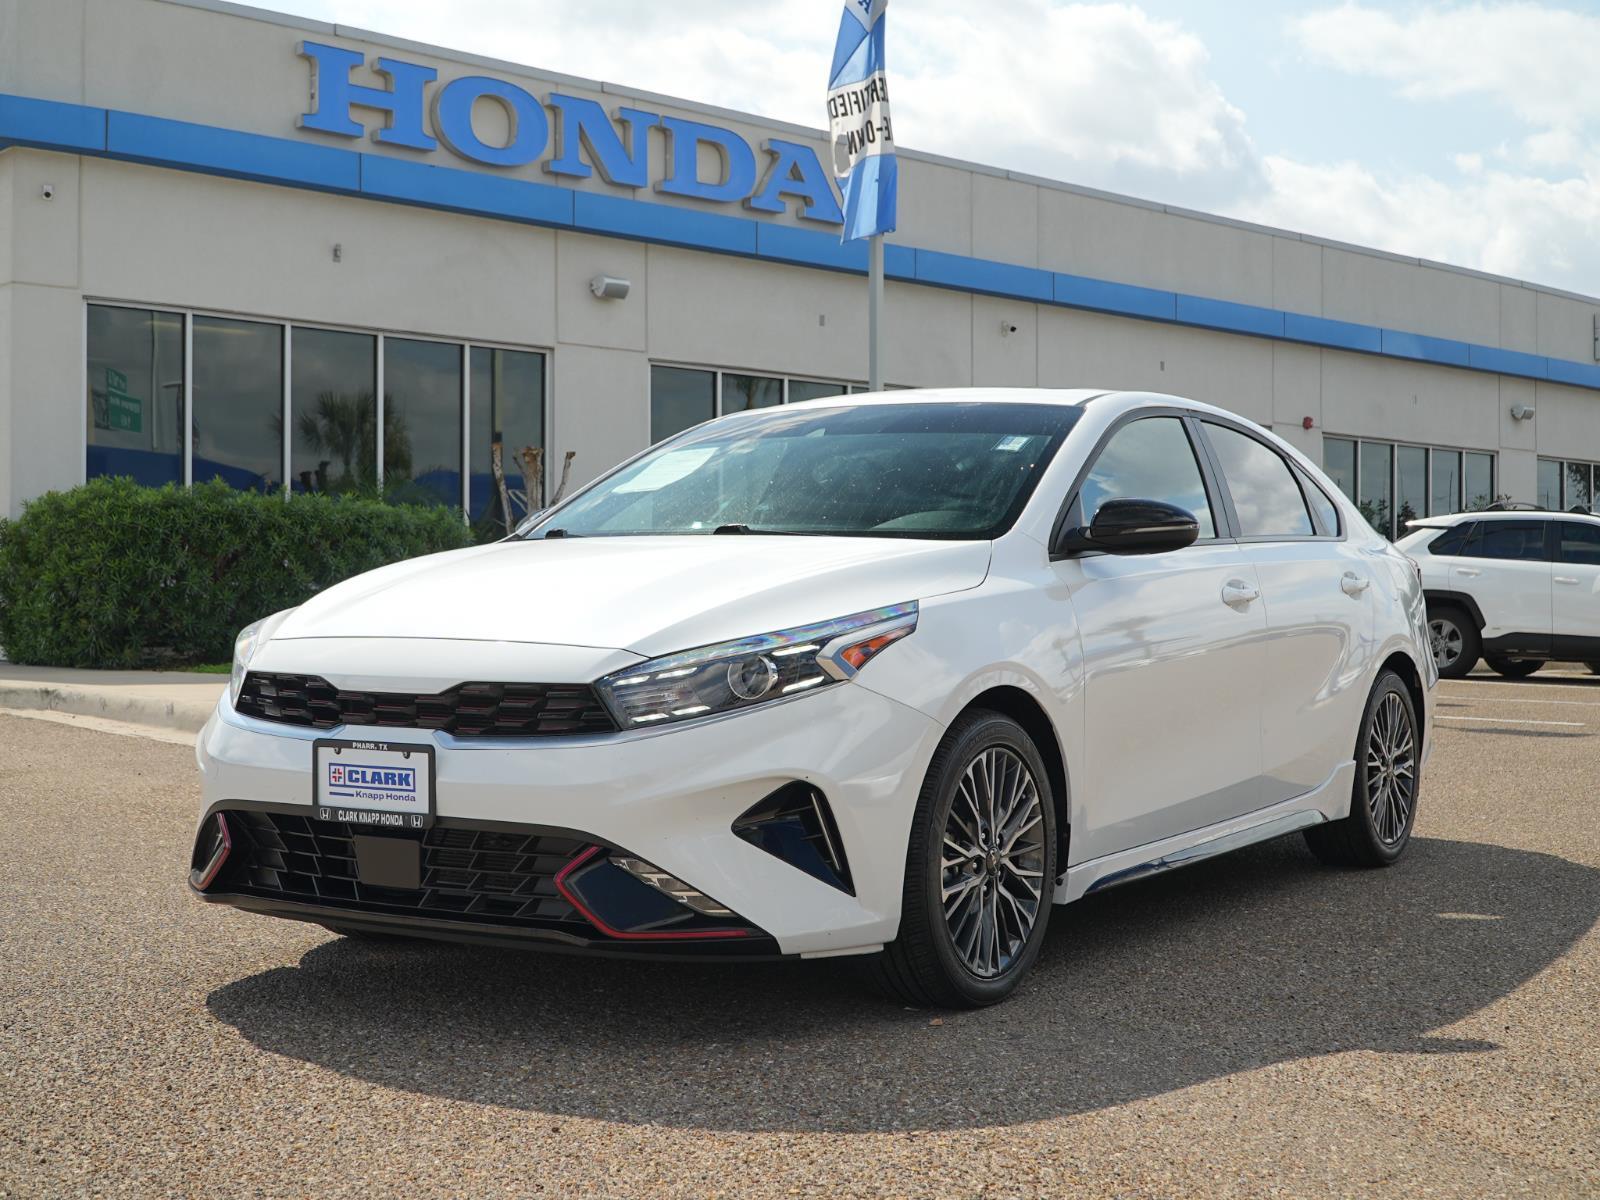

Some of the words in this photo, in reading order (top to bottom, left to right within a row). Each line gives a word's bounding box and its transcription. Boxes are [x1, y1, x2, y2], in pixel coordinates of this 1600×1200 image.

[297, 40, 844, 224] HONDA
[379, 743, 388, 751] TX
[348, 769, 411, 786] CLARK
[355, 790, 385, 800] Knapp
[386, 793, 416, 802] Honda
[338, 810, 358, 822] CLARK
[359, 812, 380, 824] KNAPP
[381, 814, 404, 826] HONDA
